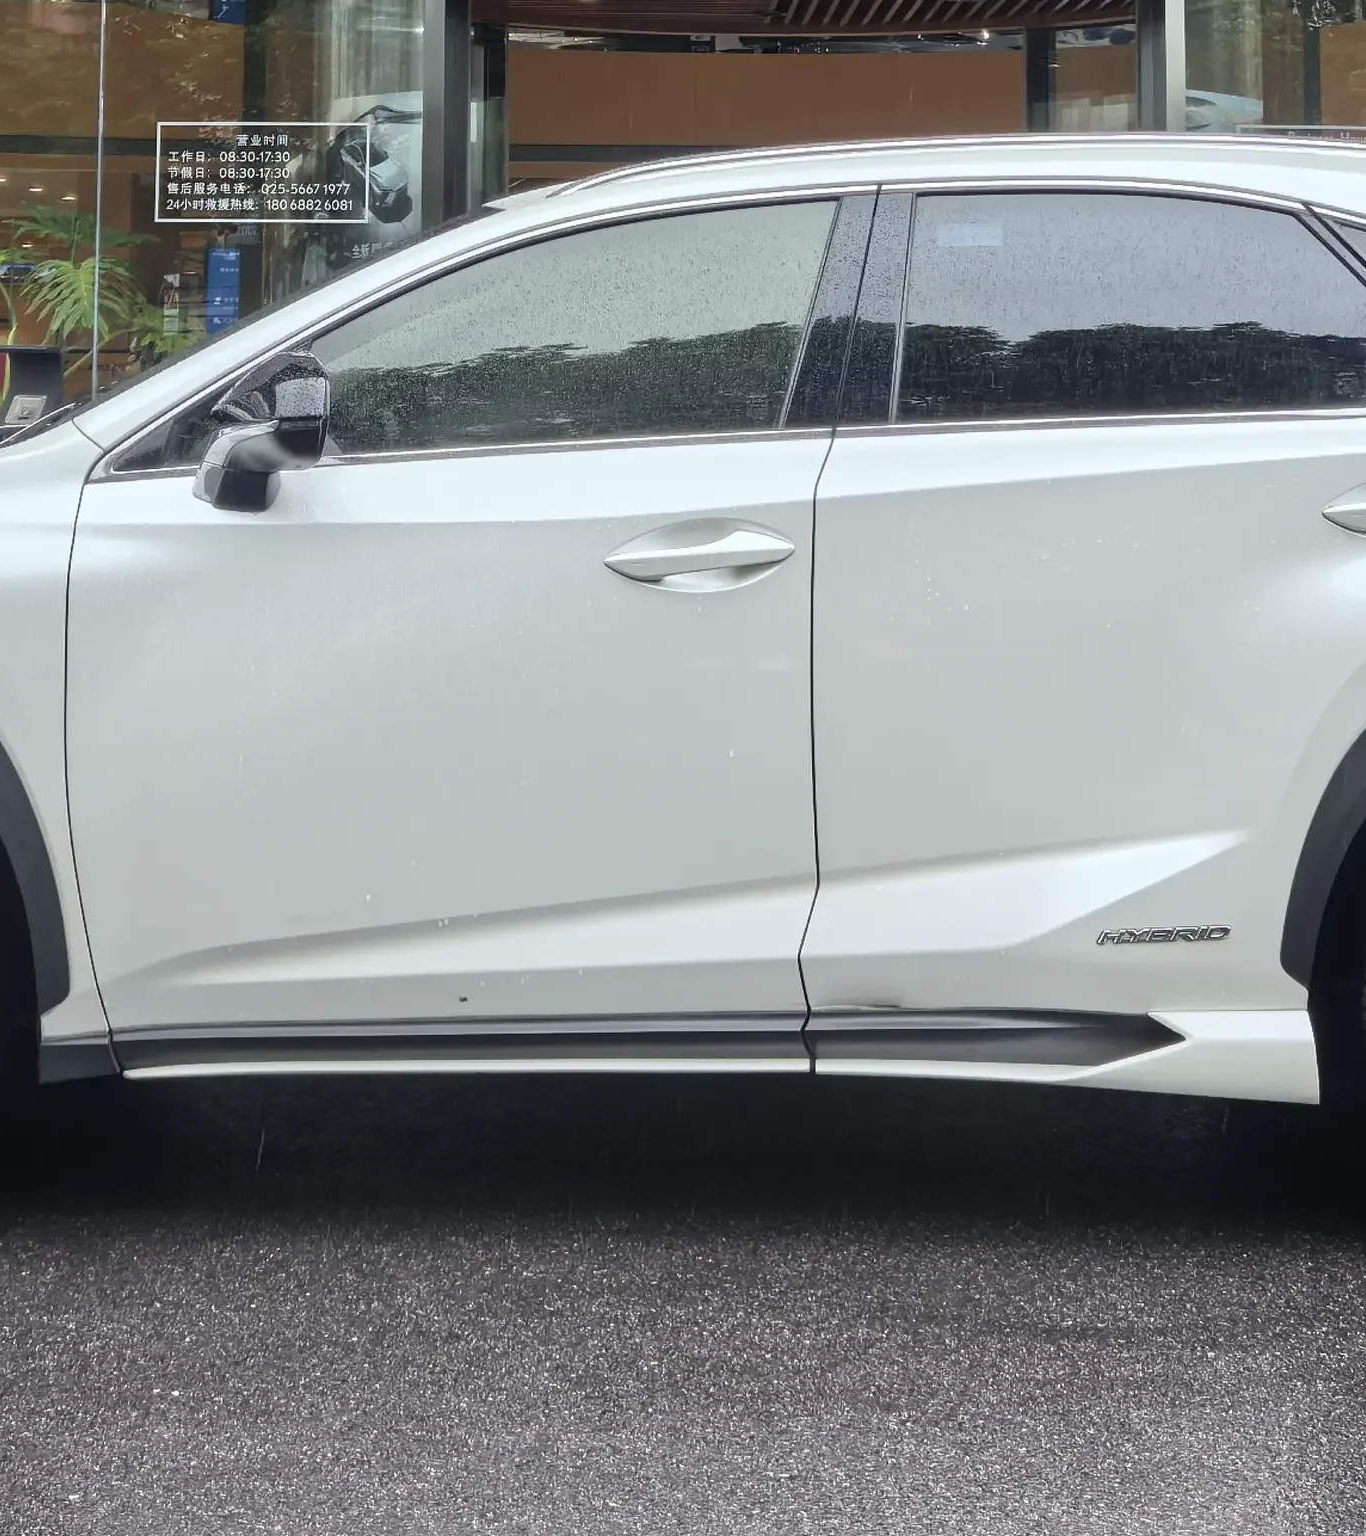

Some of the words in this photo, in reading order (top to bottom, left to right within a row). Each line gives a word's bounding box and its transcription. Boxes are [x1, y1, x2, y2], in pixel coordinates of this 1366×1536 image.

[235, 133, 289, 147] 营业时间
[219, 151, 290, 163] 08:30-17:30
[219, 167, 290, 179] 08:30-17:30
[1096, 924, 1233, 946] HYBRID
